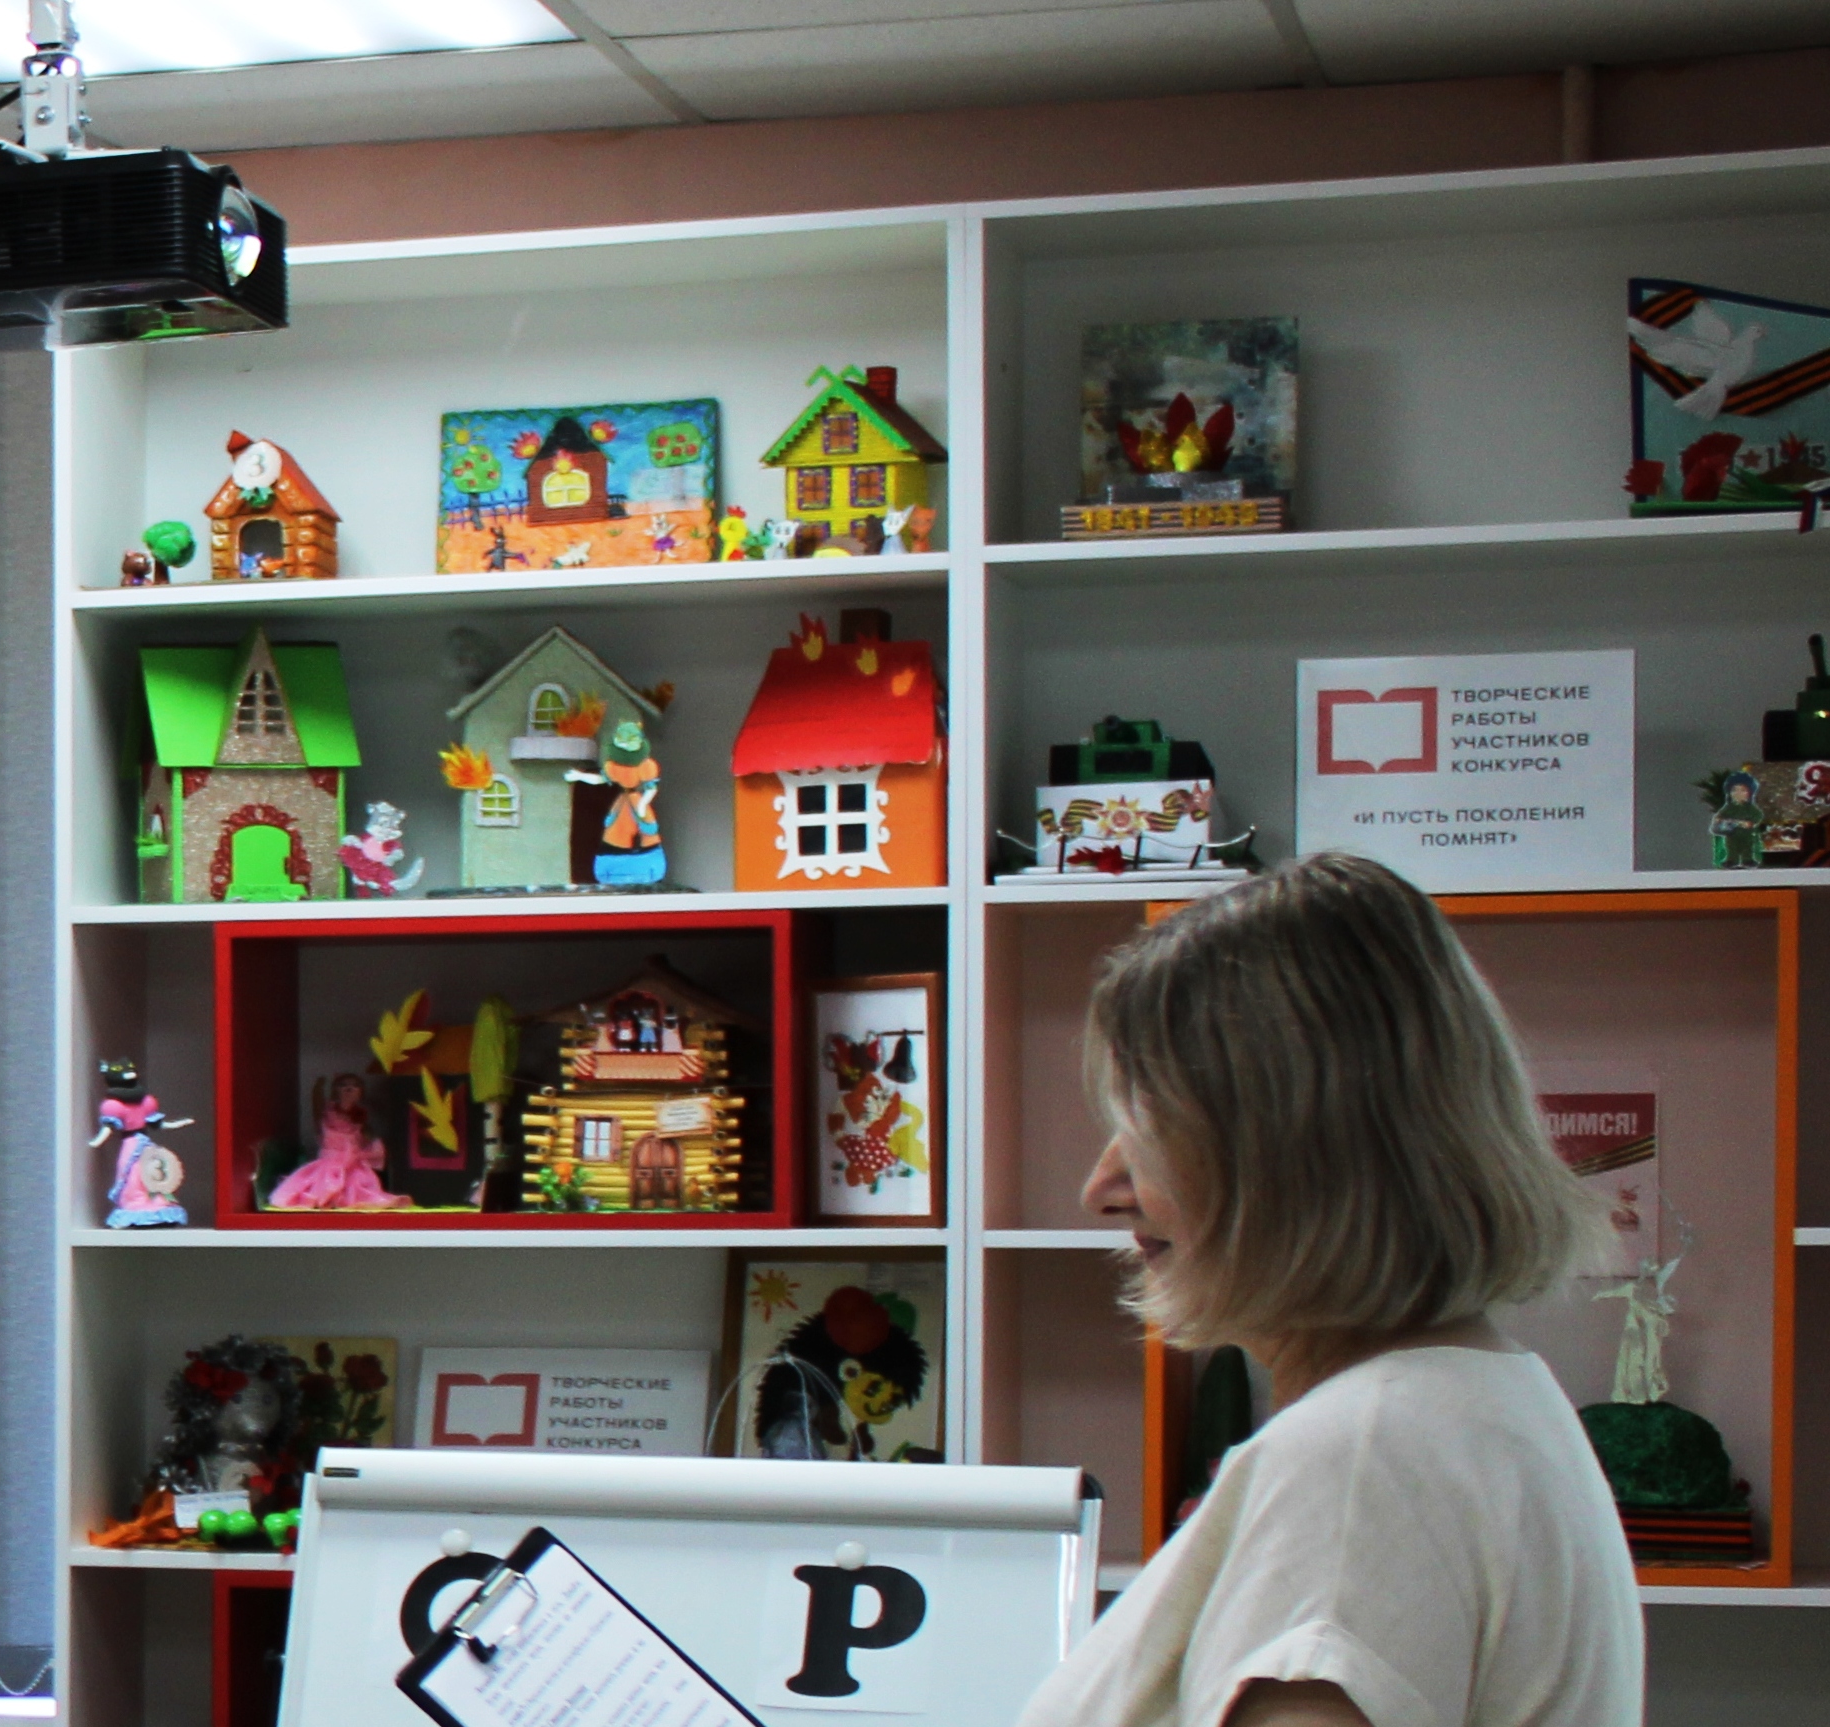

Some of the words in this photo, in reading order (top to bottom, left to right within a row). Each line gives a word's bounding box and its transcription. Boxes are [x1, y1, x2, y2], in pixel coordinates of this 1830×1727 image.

[1452, 686, 1590, 703] ТВОРЧЕСКИЕ
[1452, 710, 1537, 726] РАБОТЫ
[1452, 733, 1590, 750] УЧАСТНИКОВ
[1452, 757, 1562, 773] КОНКУРСА
[1354, 812, 1375, 825] «И
[1383, 809, 1450, 824] ПУСТЬ
[1456, 807, 1585, 823] ПОКОЛЕНИЯ
[1422, 832, 1518, 847] ПОМНЯТ»
[1547, 1112, 1638, 1138] ДИМСЯ!
[551, 1376, 672, 1391] ТВОРЧЕСКИЕ
[549, 1396, 624, 1410] РАБОТЫ
[548, 1416, 668, 1431] УЧАСТНИКОВ
[547, 1437, 642, 1450] КОНКУРСА
[786, 1564, 927, 1697] Р
